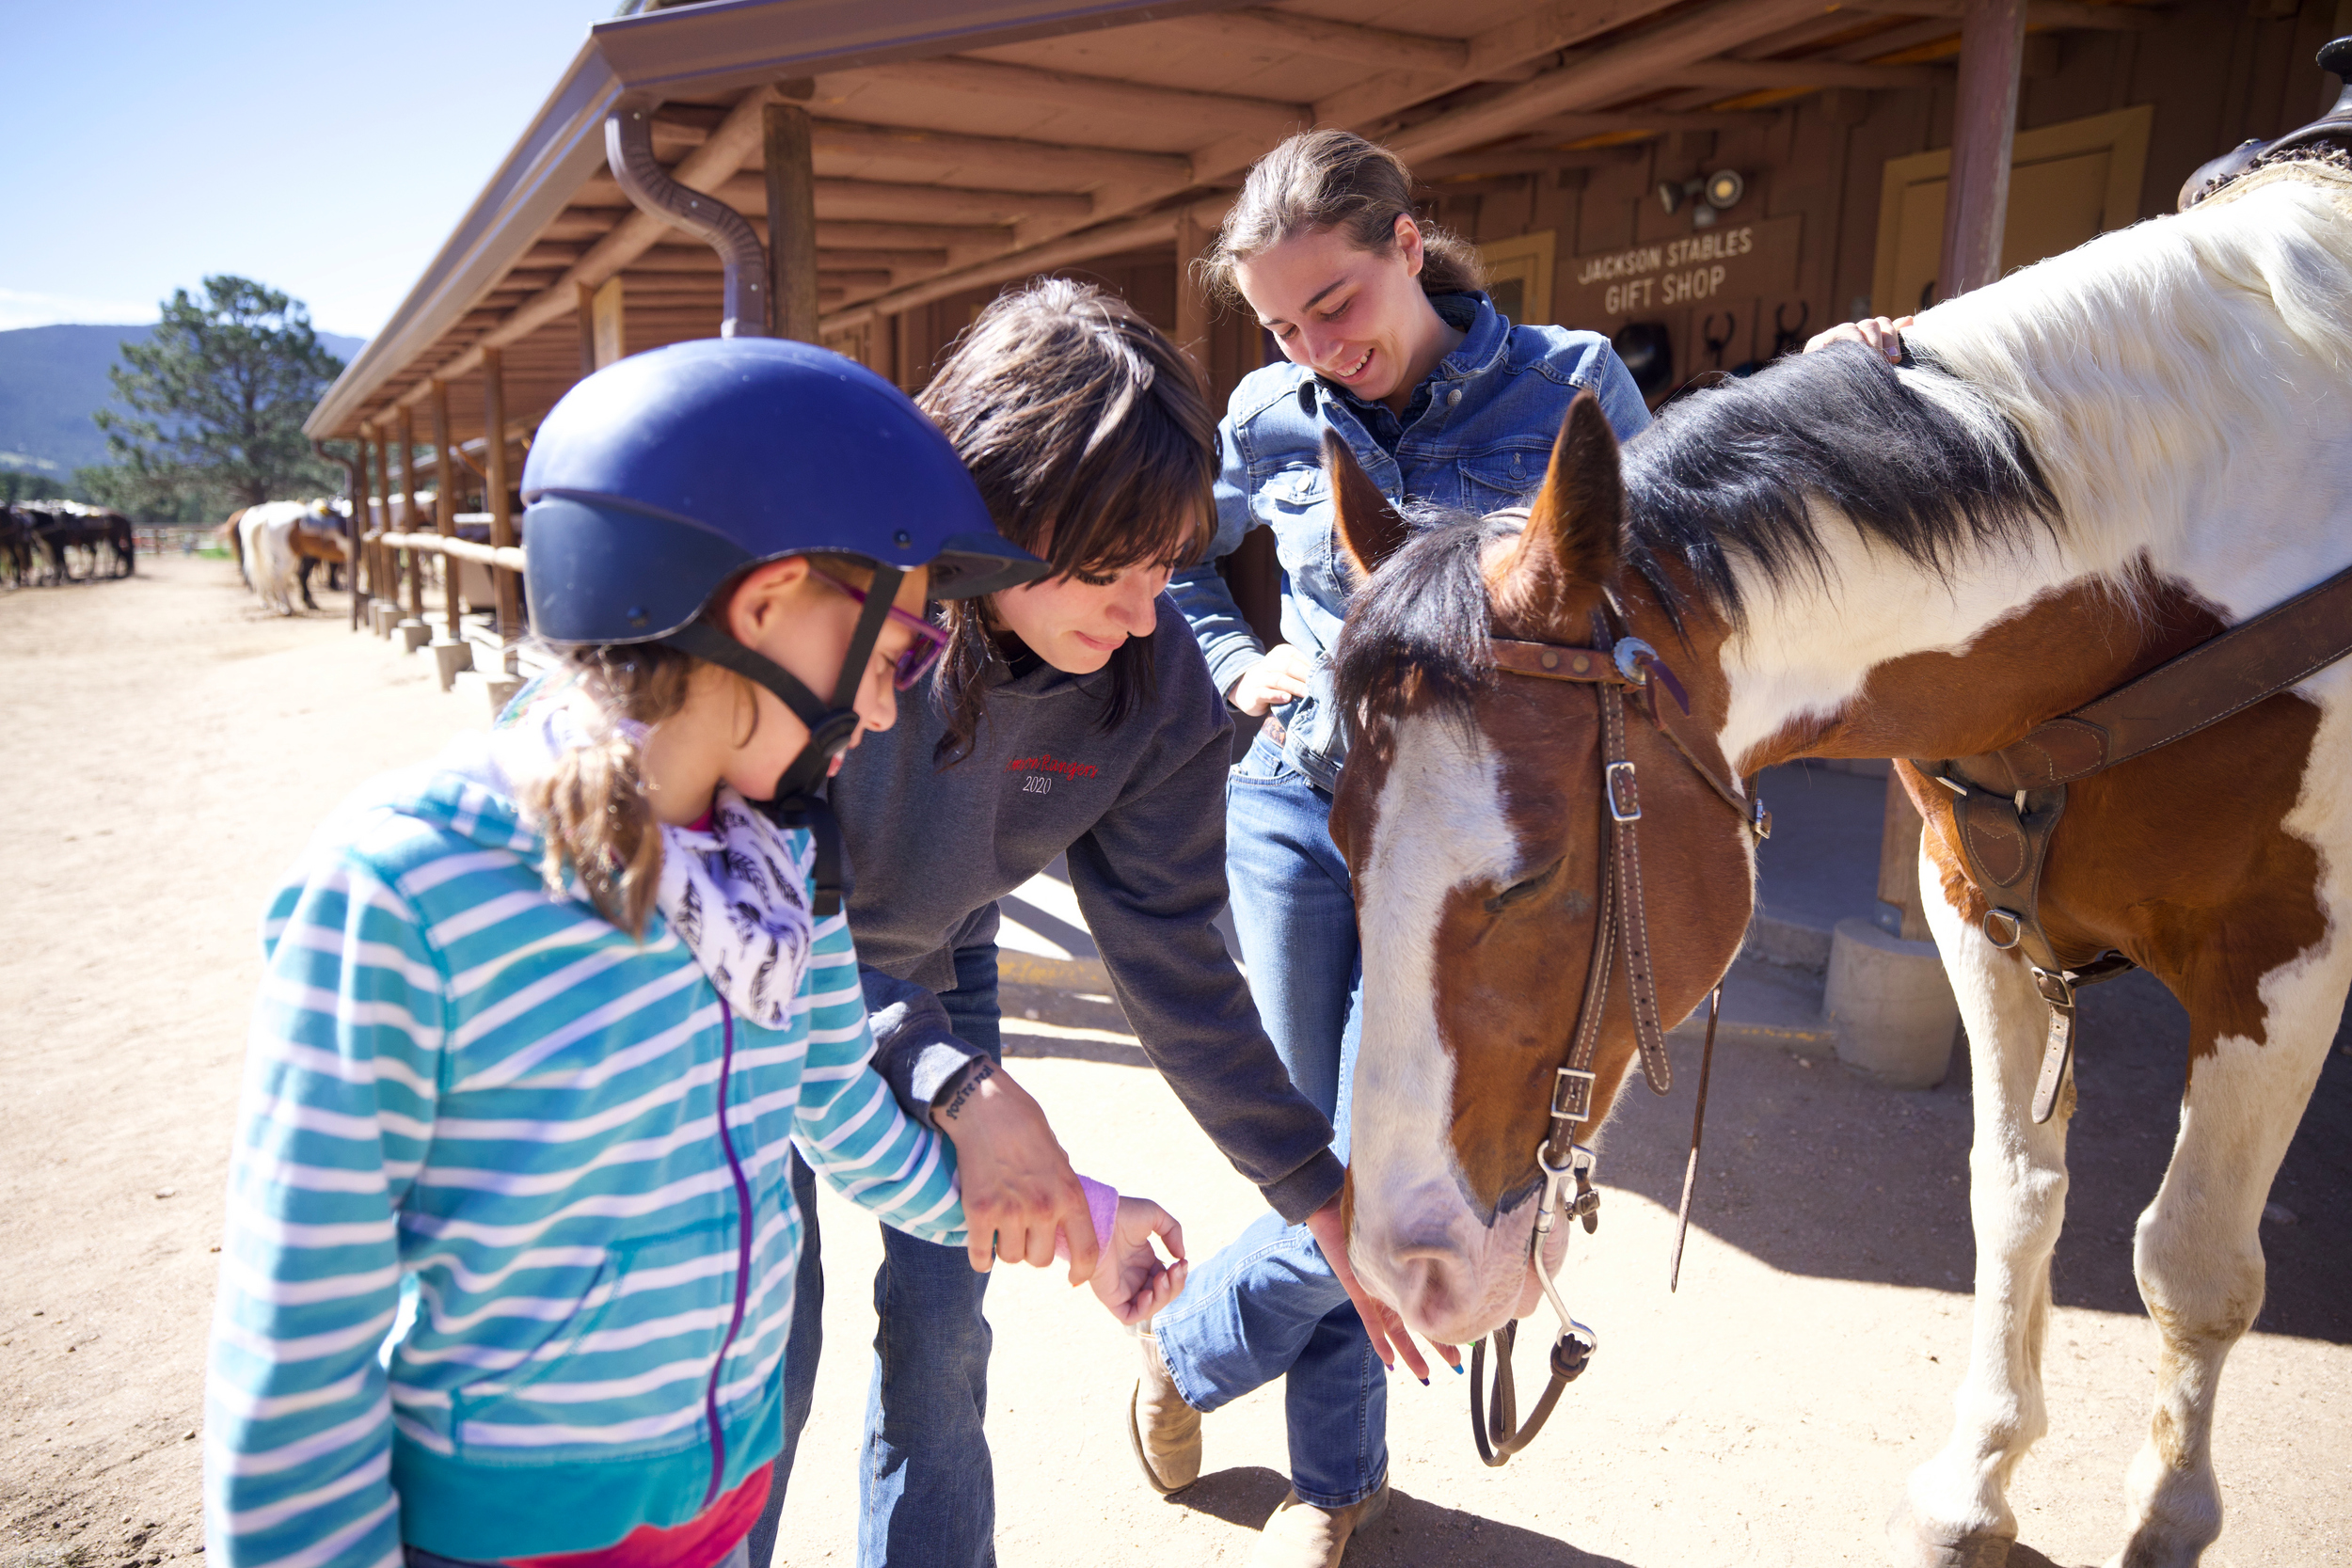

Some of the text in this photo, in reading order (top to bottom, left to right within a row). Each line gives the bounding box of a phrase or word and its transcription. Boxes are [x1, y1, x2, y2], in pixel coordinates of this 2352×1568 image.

[1578, 227, 1753, 285] JACKSON STABLES
[1605, 264, 1725, 314] GIFT SHOP
[1023, 776, 1051, 794] 2020
[946, 1064, 994, 1120] you're real
